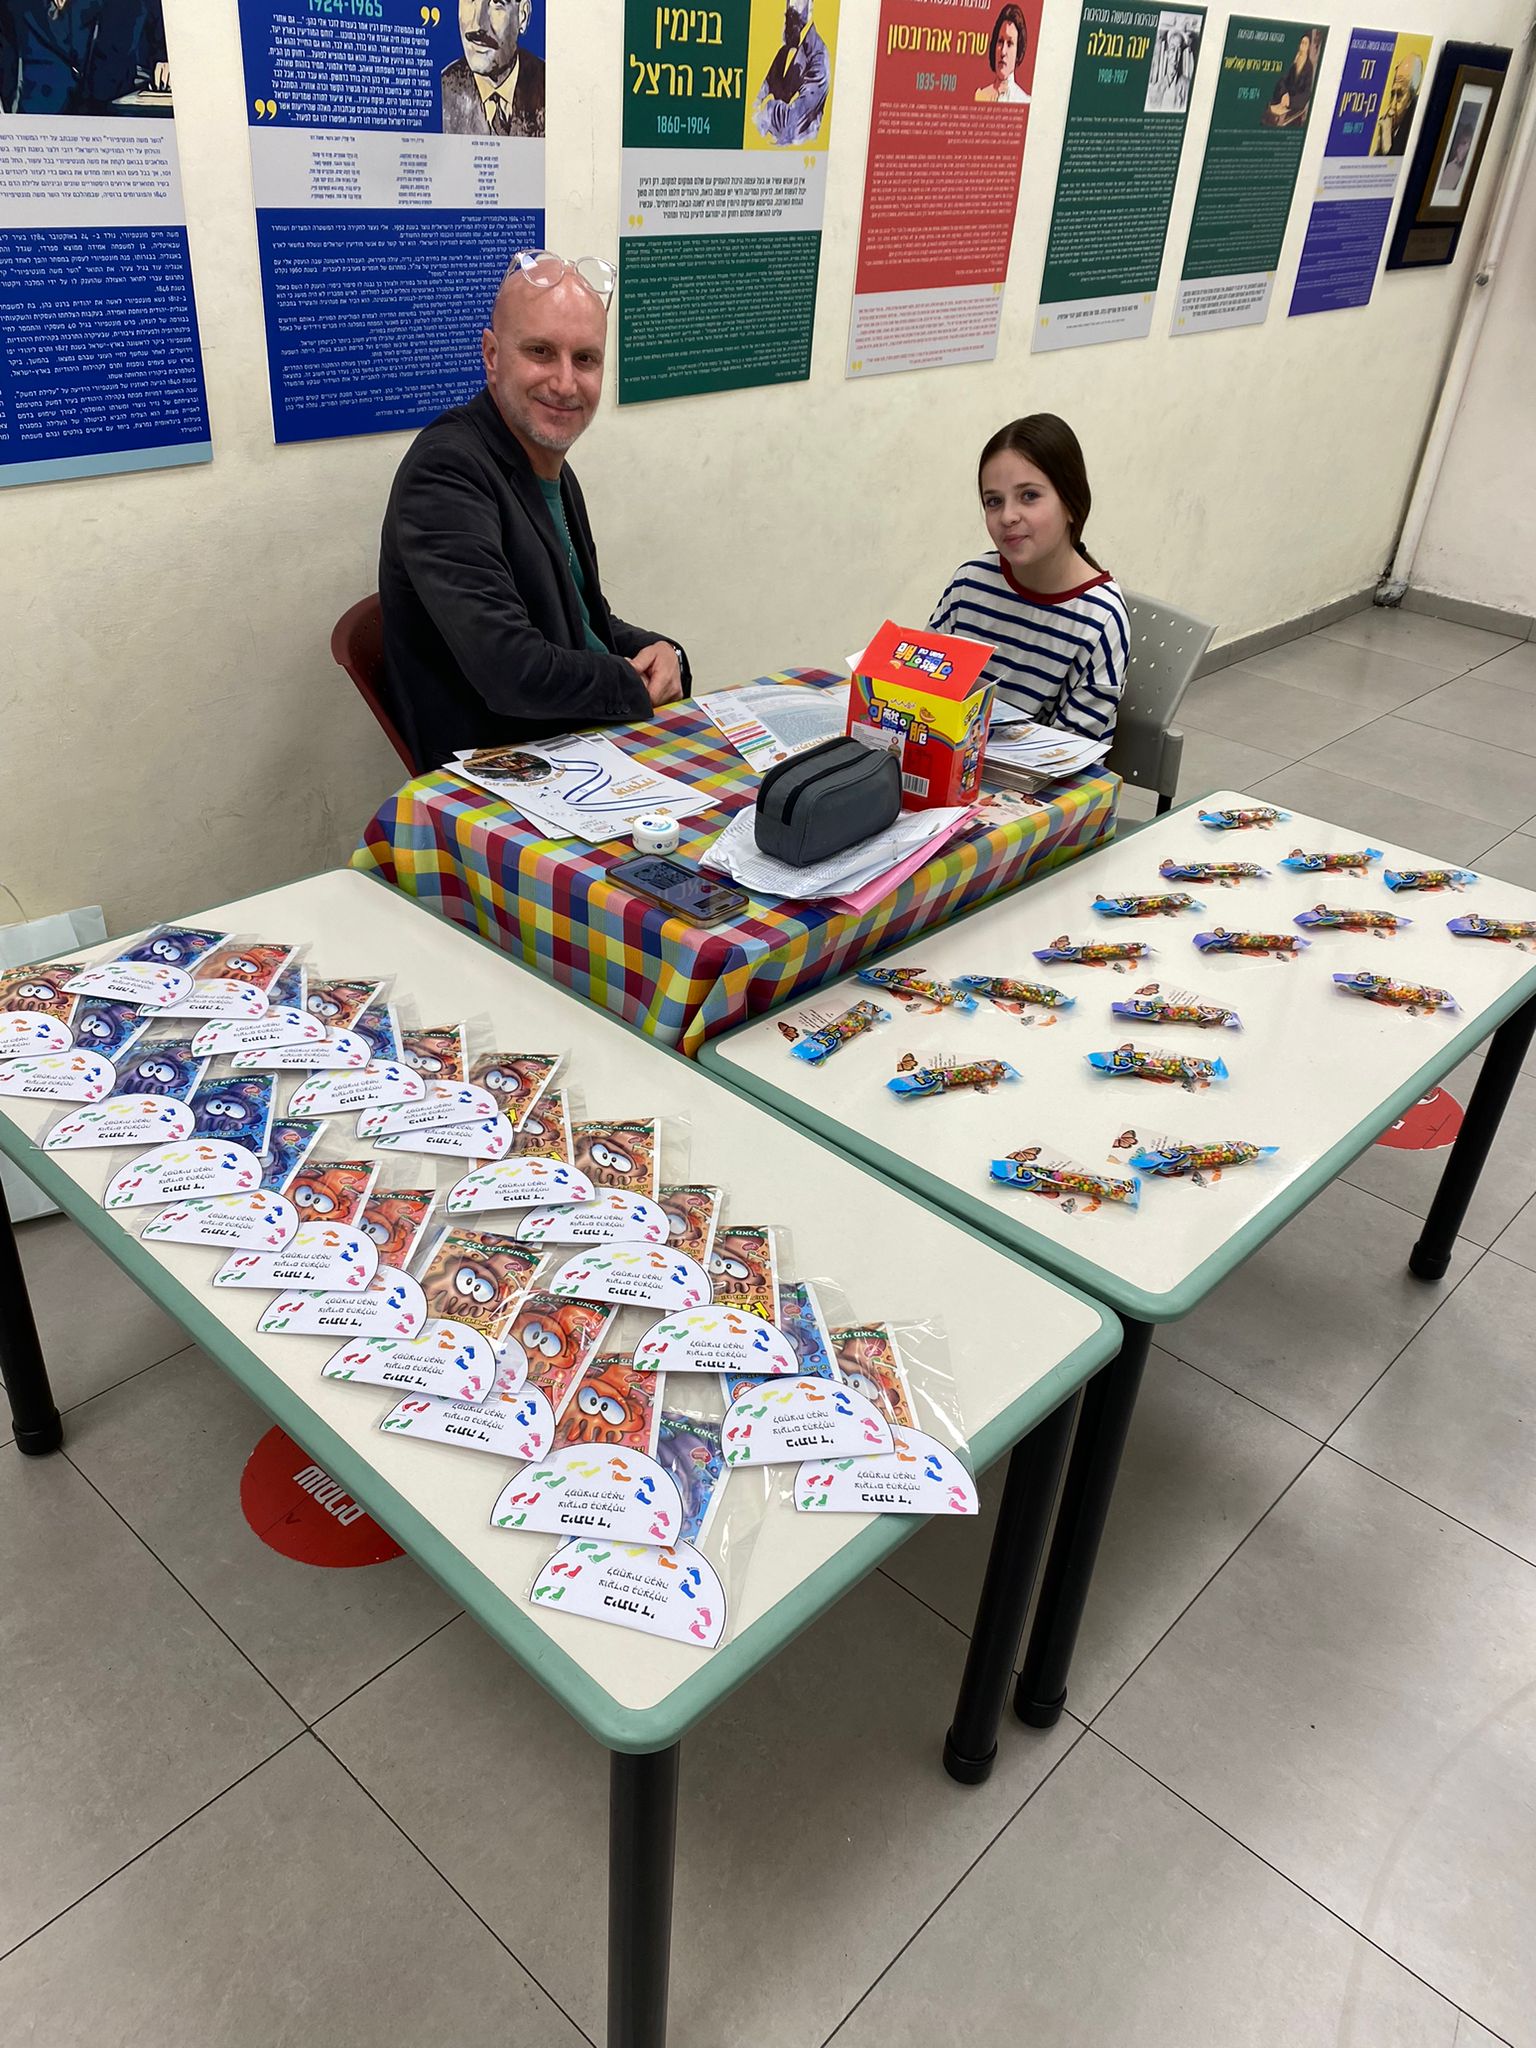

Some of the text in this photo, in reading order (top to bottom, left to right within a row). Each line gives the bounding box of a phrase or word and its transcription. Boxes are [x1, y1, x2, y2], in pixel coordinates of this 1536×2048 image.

[308, 0, 382, 17] 1924-1965
[656, 6, 722, 49] בנימין
[887, 24, 989, 56] שרה אהרונסון
[1126, 36, 1150, 59] יונה
[1361, 59, 1376, 79] דוד
[630, 54, 744, 98] זאב הרצל
[657, 115, 711, 134] 1860-1904
[241, 1034, 267, 1043] כיתה
[339, 1094, 365, 1104] כיתה
[408, 1115, 434, 1124] כיתה
[98, 1131, 126, 1139] כיתה
[162, 1183, 191, 1193] כיתה
[502, 1194, 530, 1202] כיתה
[200, 1227, 229, 1236] כיתה
[572, 1228, 600, 1236] כיתה
[508, 1249, 530, 1260] מאכל
[272, 1270, 303, 1279] כיתה
[607, 1286, 637, 1297] כיתה
[318, 1317, 349, 1325] כיתה
[694, 1359, 726, 1369] כיתה
[382, 1372, 414, 1383] כיתה
[444, 1423, 477, 1438] כיתה
[785, 1435, 818, 1448] כיתה
[292, 1464, 366, 1527] שומרים
[861, 1493, 894, 1503] כיתה
[560, 1513, 595, 1526] כיתה
[603, 1595, 639, 1613] כיתה
